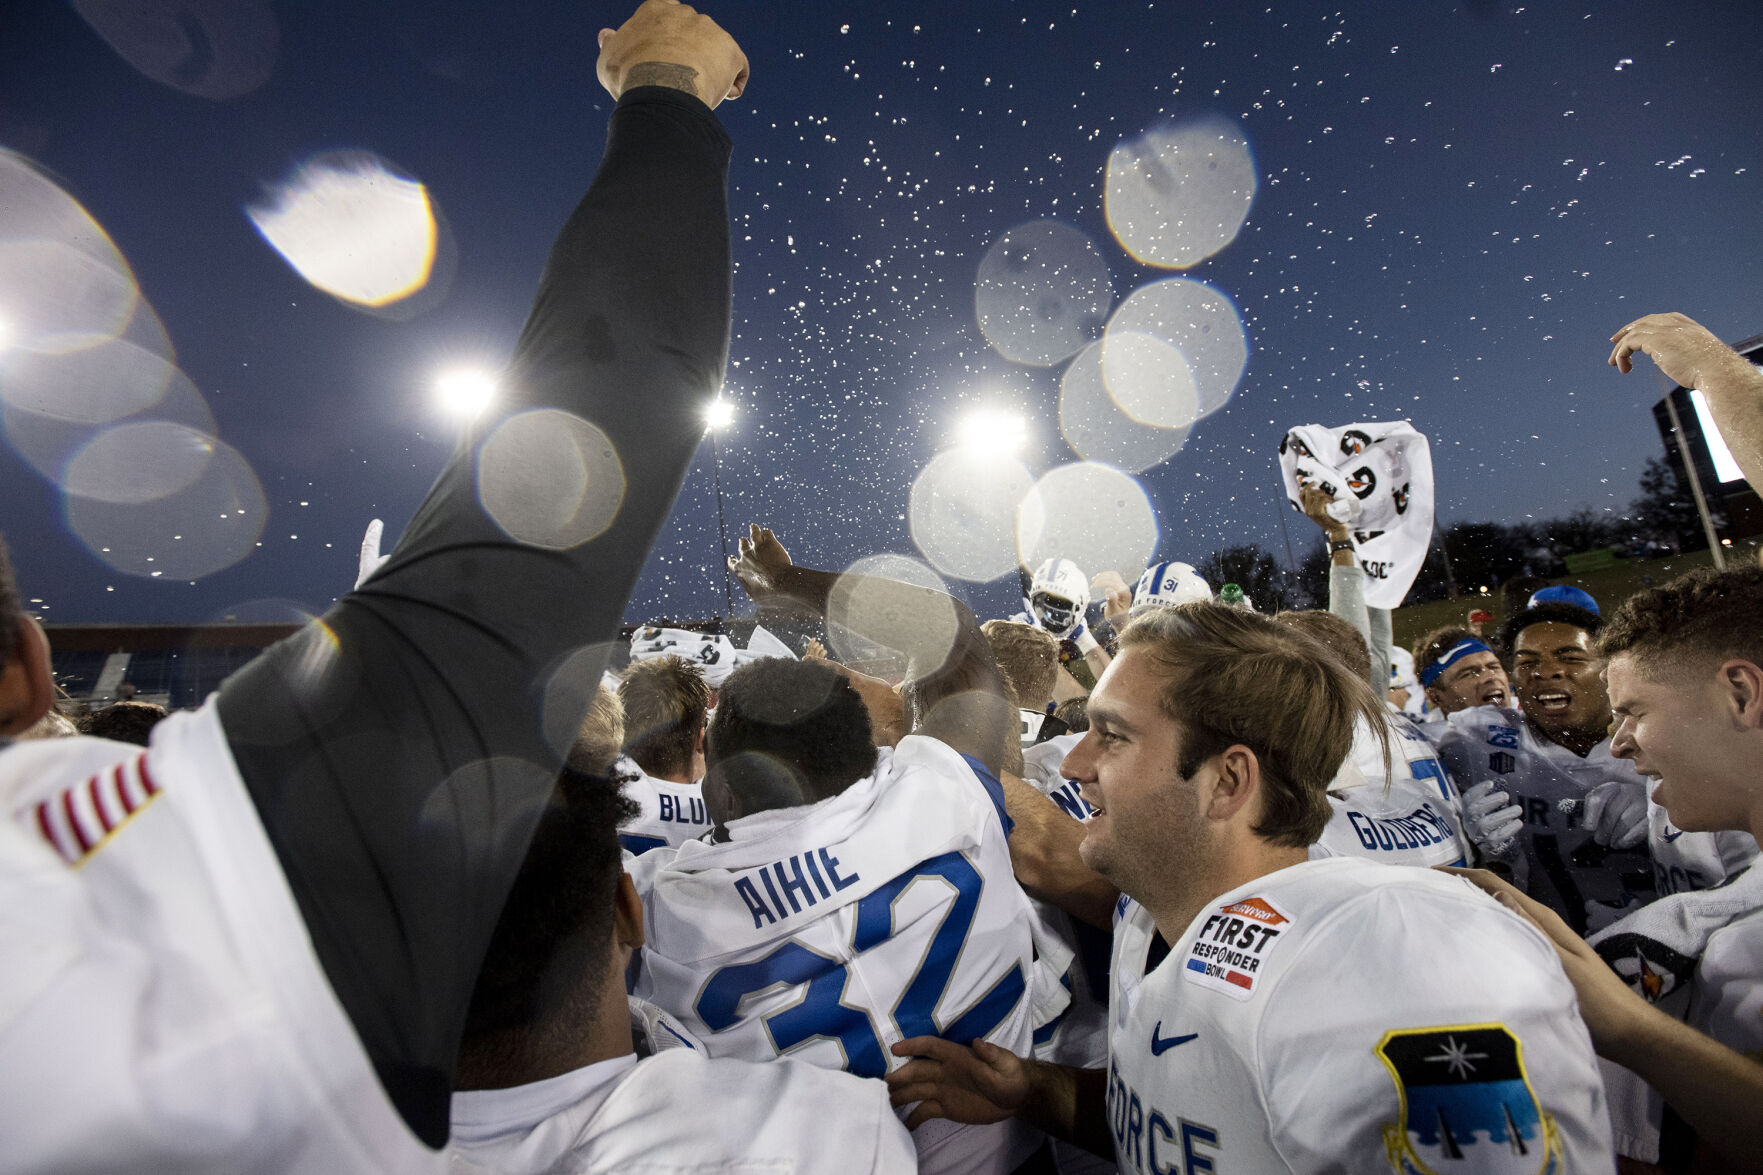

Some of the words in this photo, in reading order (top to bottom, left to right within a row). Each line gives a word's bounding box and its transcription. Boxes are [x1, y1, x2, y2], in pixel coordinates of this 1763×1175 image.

[1163, 579, 1178, 593] 31
[658, 793, 712, 826] BLU
[1346, 803, 1454, 850] GOLDBERG
[734, 847, 860, 929] AIHIE
[694, 850, 1029, 1078] 32
[1192, 942, 1260, 973] RESPONDER
[1205, 963, 1226, 980] BOWL
[1106, 1056, 1223, 1175] FORCE
